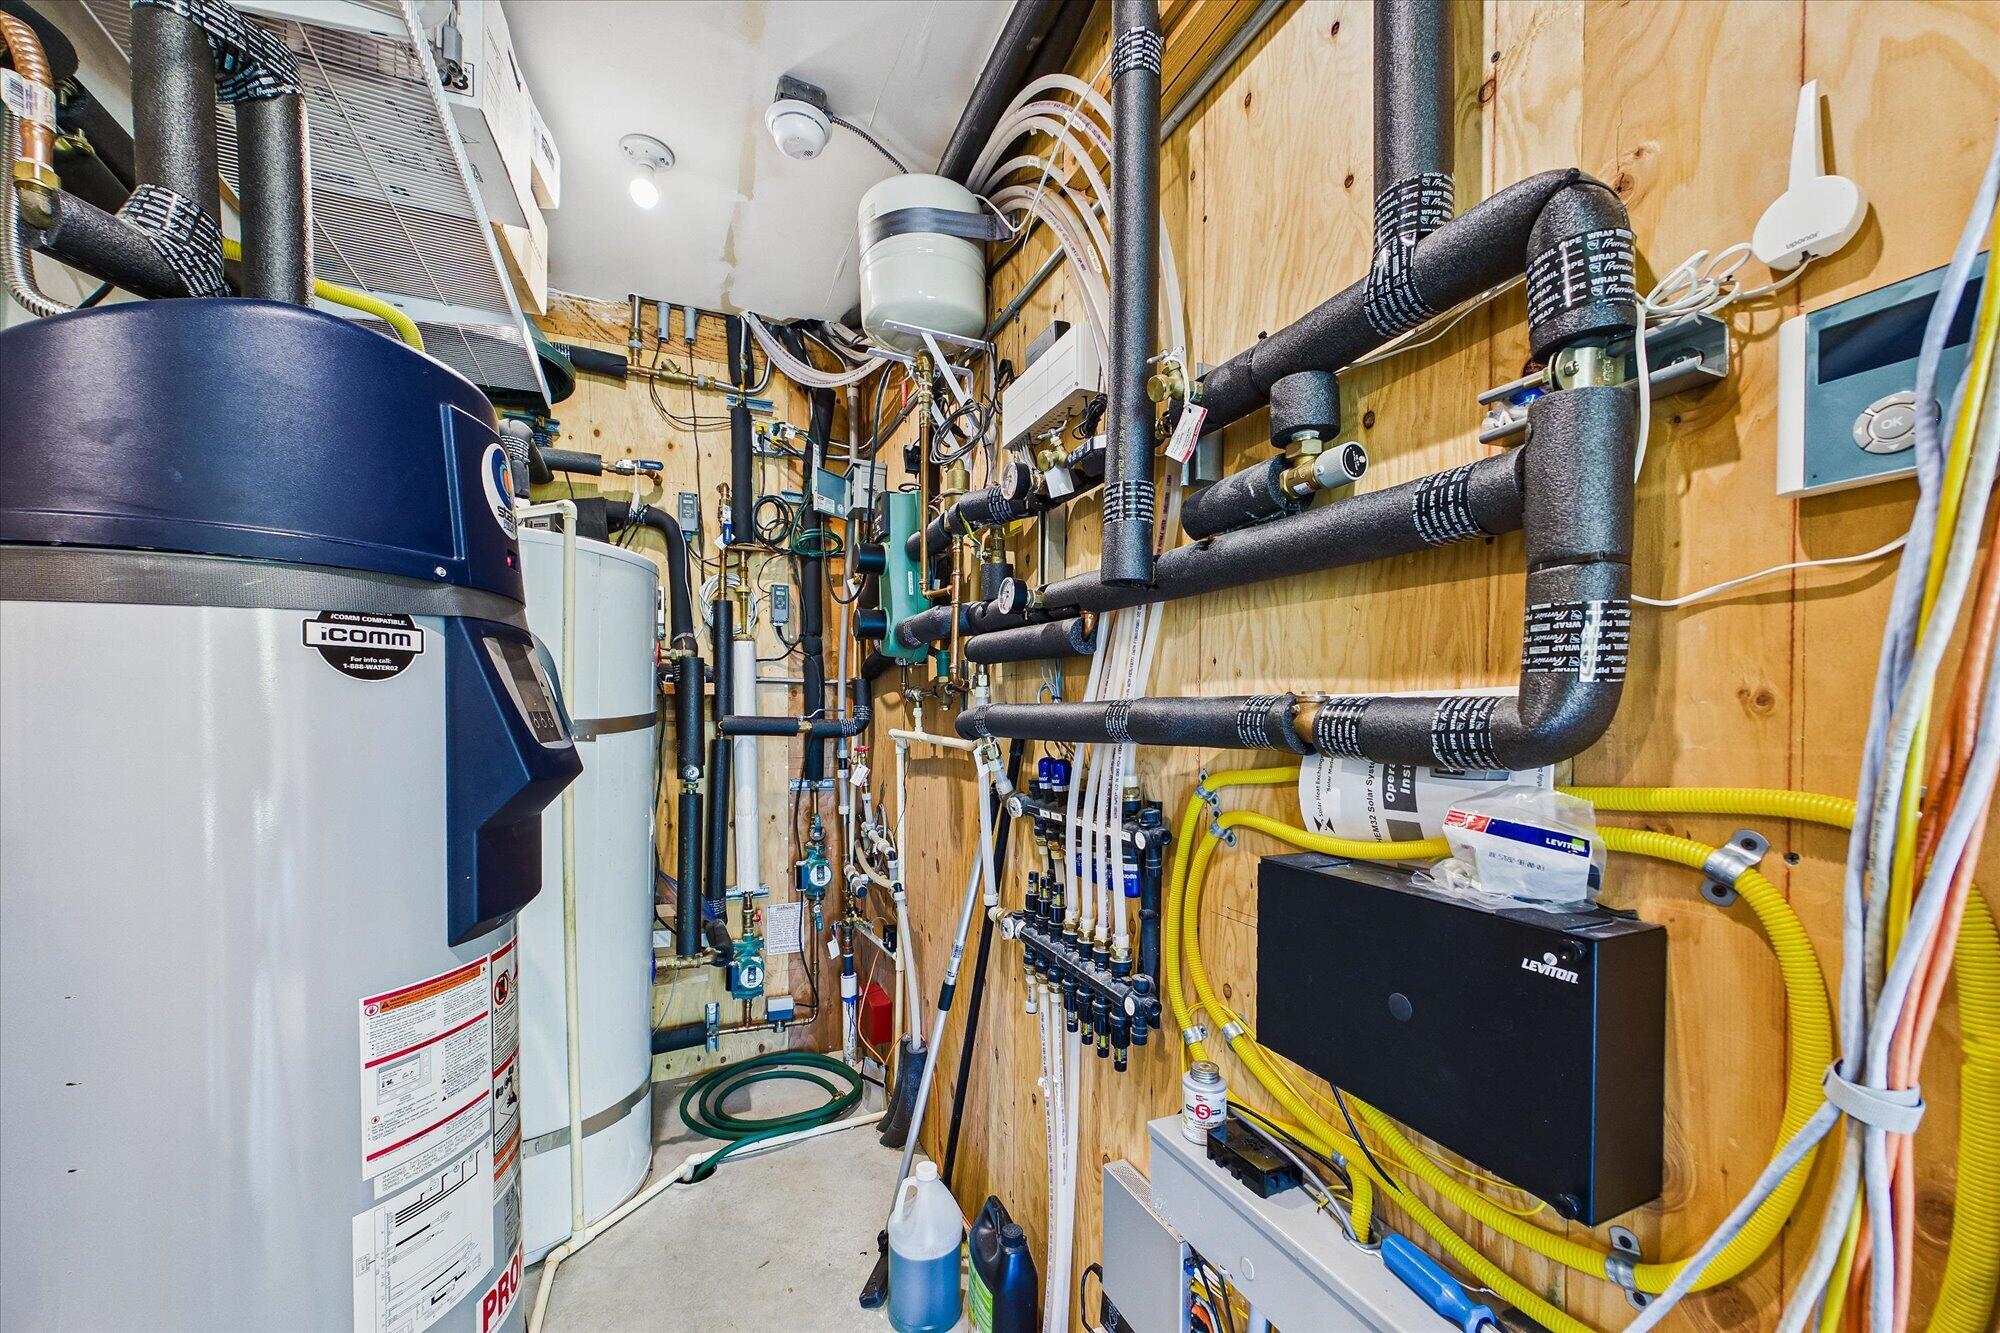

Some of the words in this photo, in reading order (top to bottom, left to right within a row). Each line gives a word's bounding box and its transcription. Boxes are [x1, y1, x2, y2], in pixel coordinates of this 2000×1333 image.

[1401, 192, 1419, 202] PIPE
[1400, 210, 1418, 220] PIPE
[1534, 248, 1557, 267] 20MIL
[1587, 230, 1614, 240] WRAP
[1530, 262, 1550, 281] WRAP
[1536, 271, 1559, 289] 20MIL
[1589, 253, 1617, 263] WRAP
[1532, 285, 1552, 303] WRAP
[1538, 292, 1561, 310] 20MIL
[1591, 276, 1619, 286] WRAP
[1534, 307, 1554, 324] WRAP
[1881, 416, 1903, 430] OK
[1422, 516, 1433, 534] WRAP
[1439, 511, 1450, 530] WRAP
[1458, 506, 1470, 525] WRAP
[1552, 644, 1580, 652] WRAP
[1432, 711, 1440, 731] WRAP
[1450, 711, 1458, 731] WRAP
[1469, 709, 1478, 730] WRAP
[1431, 734, 1439, 750] PIPE
[1366, 761, 1376, 786] Syste
[1386, 763, 1396, 802] Opera
[1366, 788, 1375, 812] Solar
[1198, 1106, 1208, 1118] 5
